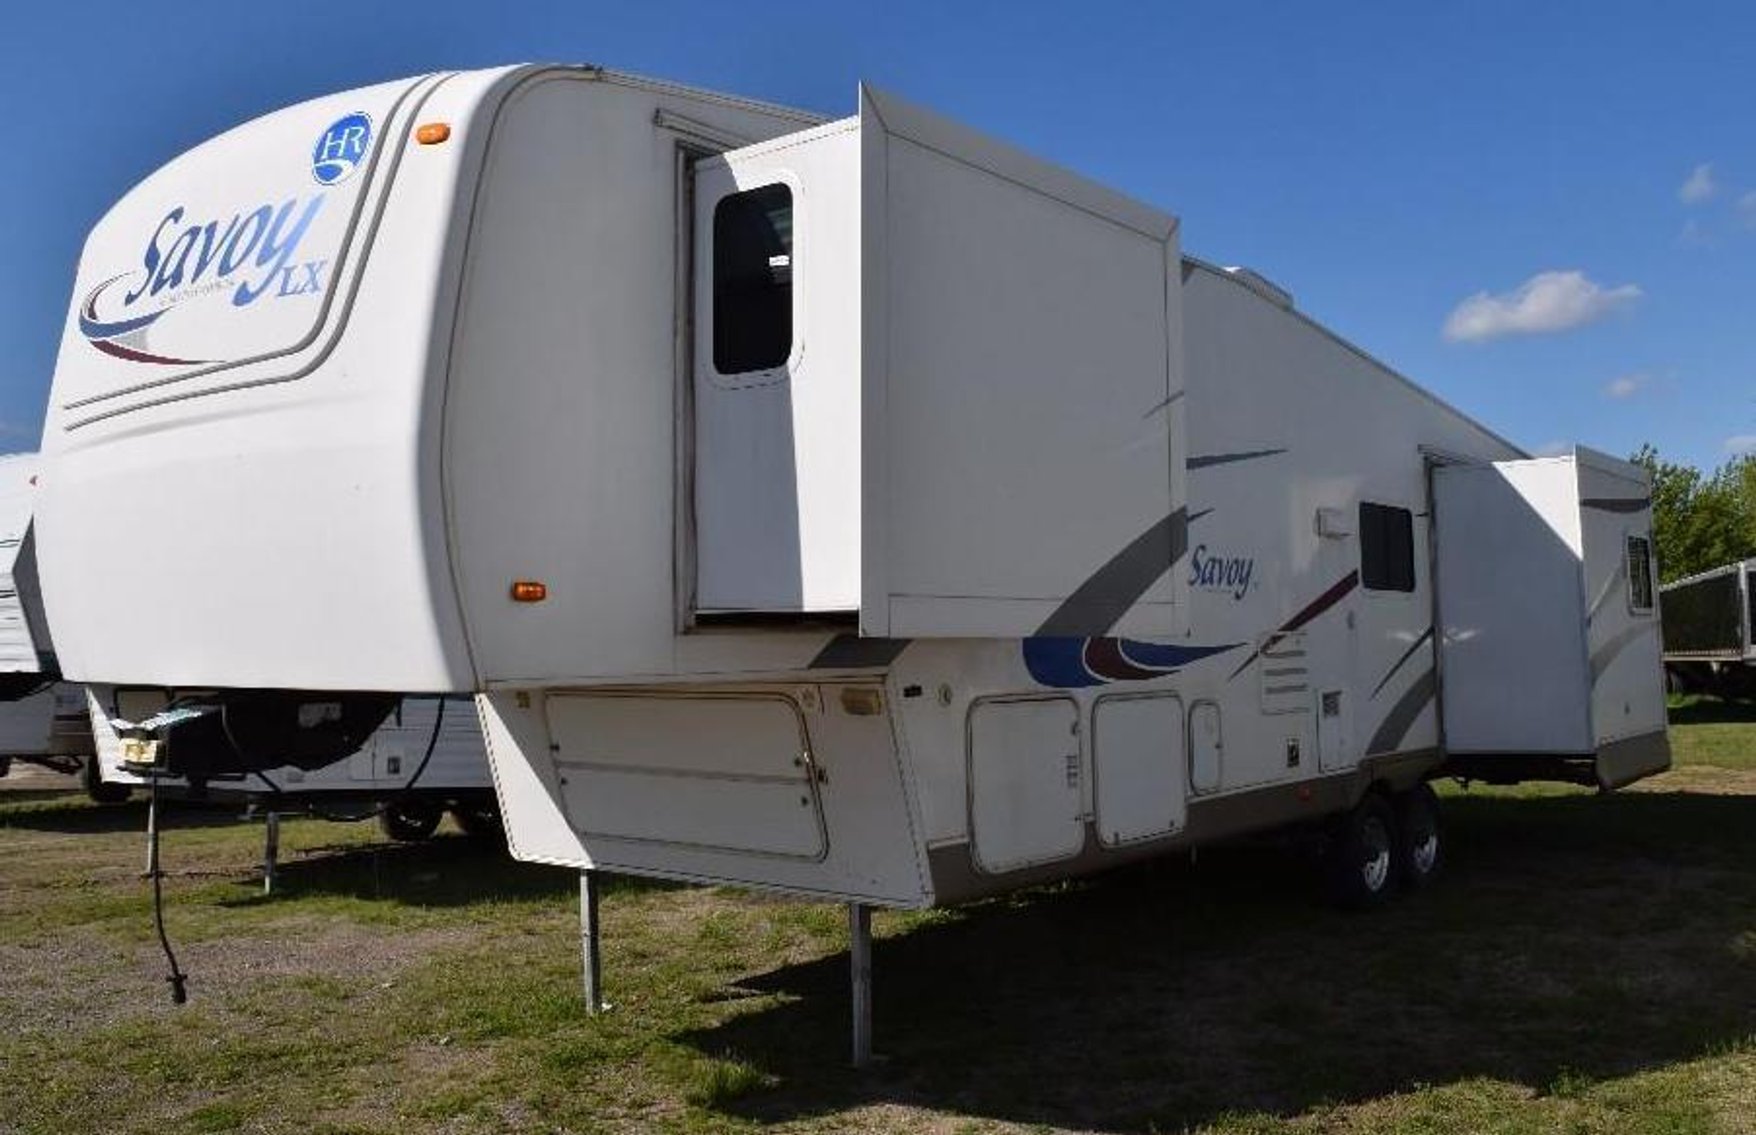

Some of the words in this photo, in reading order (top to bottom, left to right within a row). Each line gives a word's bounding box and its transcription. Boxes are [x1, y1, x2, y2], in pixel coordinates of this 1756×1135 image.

[321, 126, 365, 159] HR
[124, 193, 327, 307] Savoy
[276, 259, 328, 298] LX
[1187, 544, 1254, 600] Savoy
